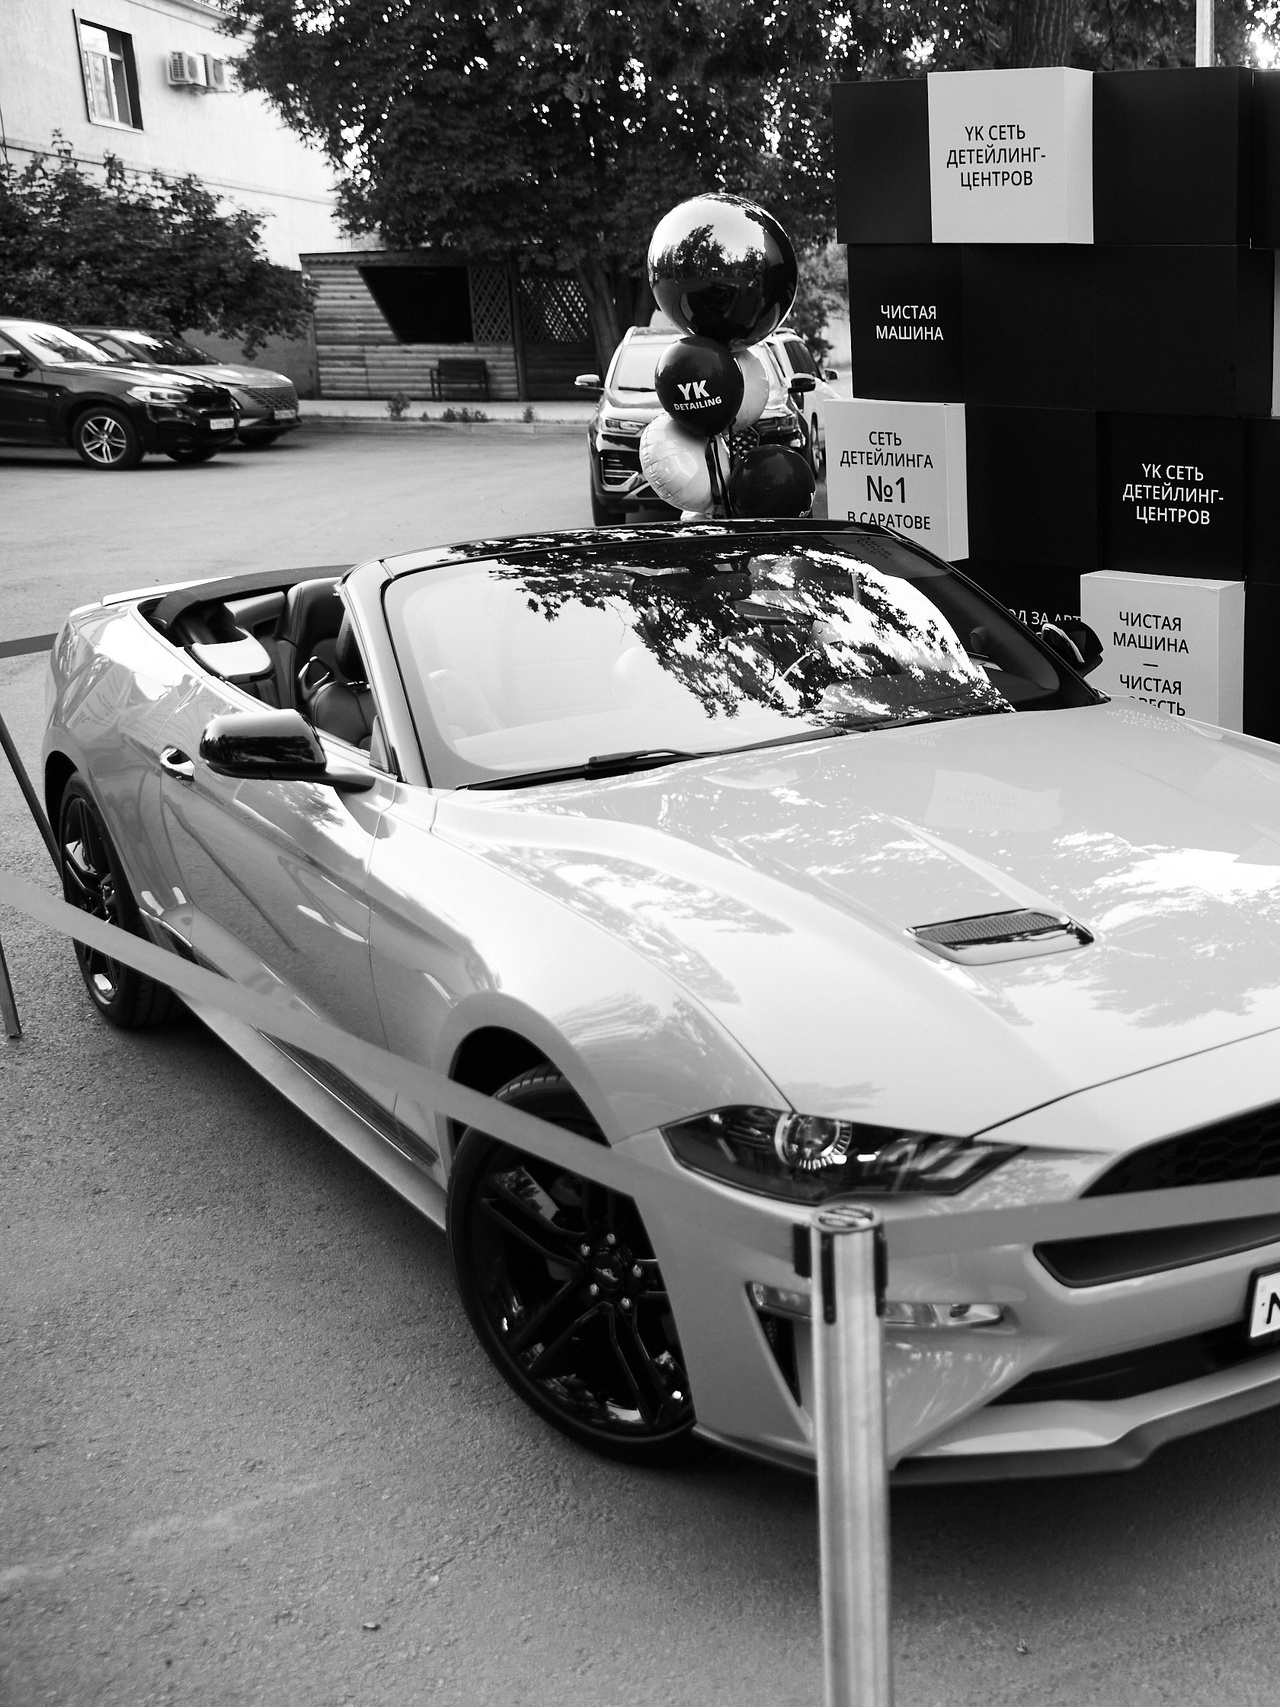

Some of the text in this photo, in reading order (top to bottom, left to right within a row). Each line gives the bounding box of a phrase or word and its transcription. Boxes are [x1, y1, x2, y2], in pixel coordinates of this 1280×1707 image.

[988, 125, 1026, 141] СЕТЬ
[946, 144, 1046, 169] ДЕТЕЙЛИНГ-
[960, 170, 1033, 191] ЦЕНТРОВ
[880, 304, 937, 320] ЧИСТАЯ
[876, 325, 944, 341] МАШИНА
[677, 380, 710, 400] YK
[673, 396, 722, 410] DETAILING
[868, 431, 902, 447] СЕТЬ
[839, 447, 934, 469] ДЕТЕЙЛИНГА
[1166, 465, 1204, 481] СЕТЬ
[866, 475, 907, 504] №1
[1122, 483, 1224, 503] ДЕТЕЙЛИНГ-
[859, 511, 931, 531] САРАТОВЕ
[1136, 505, 1210, 525] ЦЕНТРОВ
[1119, 611, 1182, 632] ЧИСТАЯ
[1113, 631, 1190, 654] МАШИНА
[1119, 674, 1182, 696] ЧИСТАЯ
